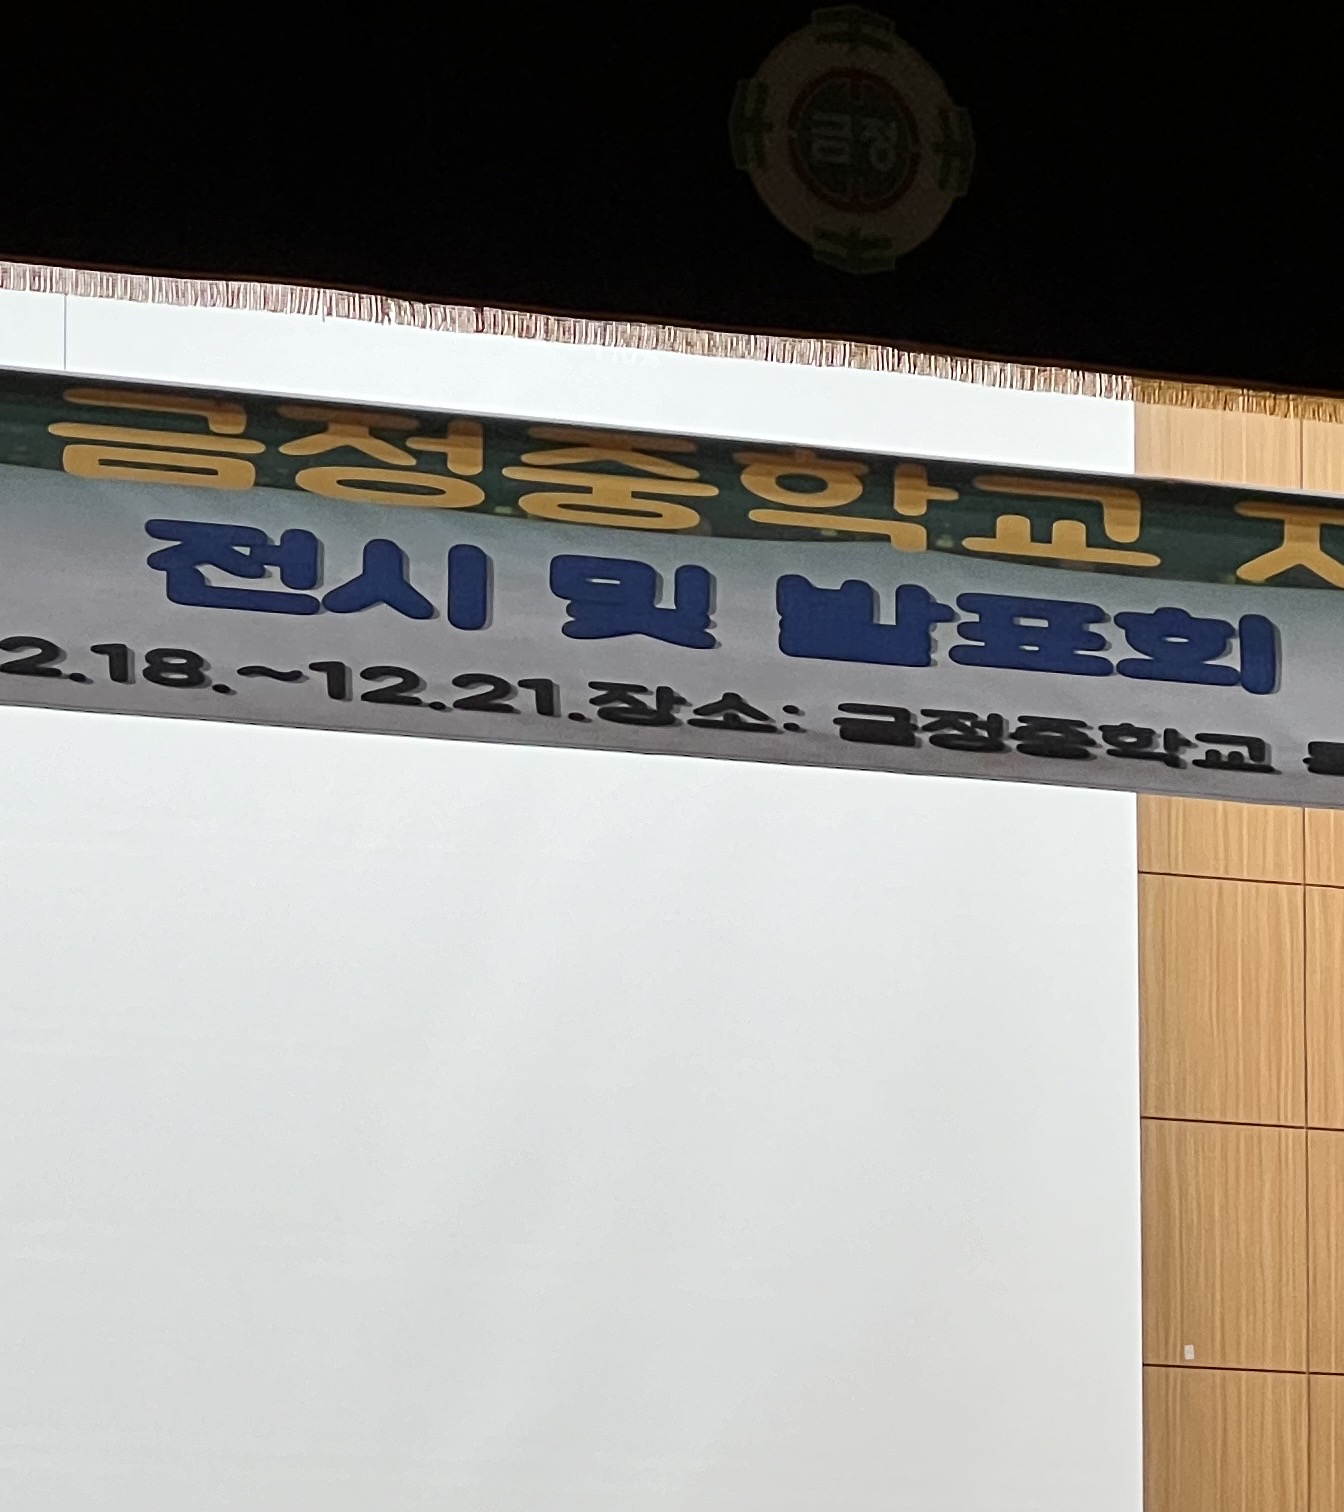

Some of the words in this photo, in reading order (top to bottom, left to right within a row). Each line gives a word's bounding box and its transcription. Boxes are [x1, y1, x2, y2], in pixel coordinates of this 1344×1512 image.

[47, 387, 1162, 567] 금정중학교
[144, 518, 492, 631] 전시
[549, 553, 719, 650] 및
[775, 574, 1280, 695] 발표회
[832, 702, 1281, 775] 금정중학교
